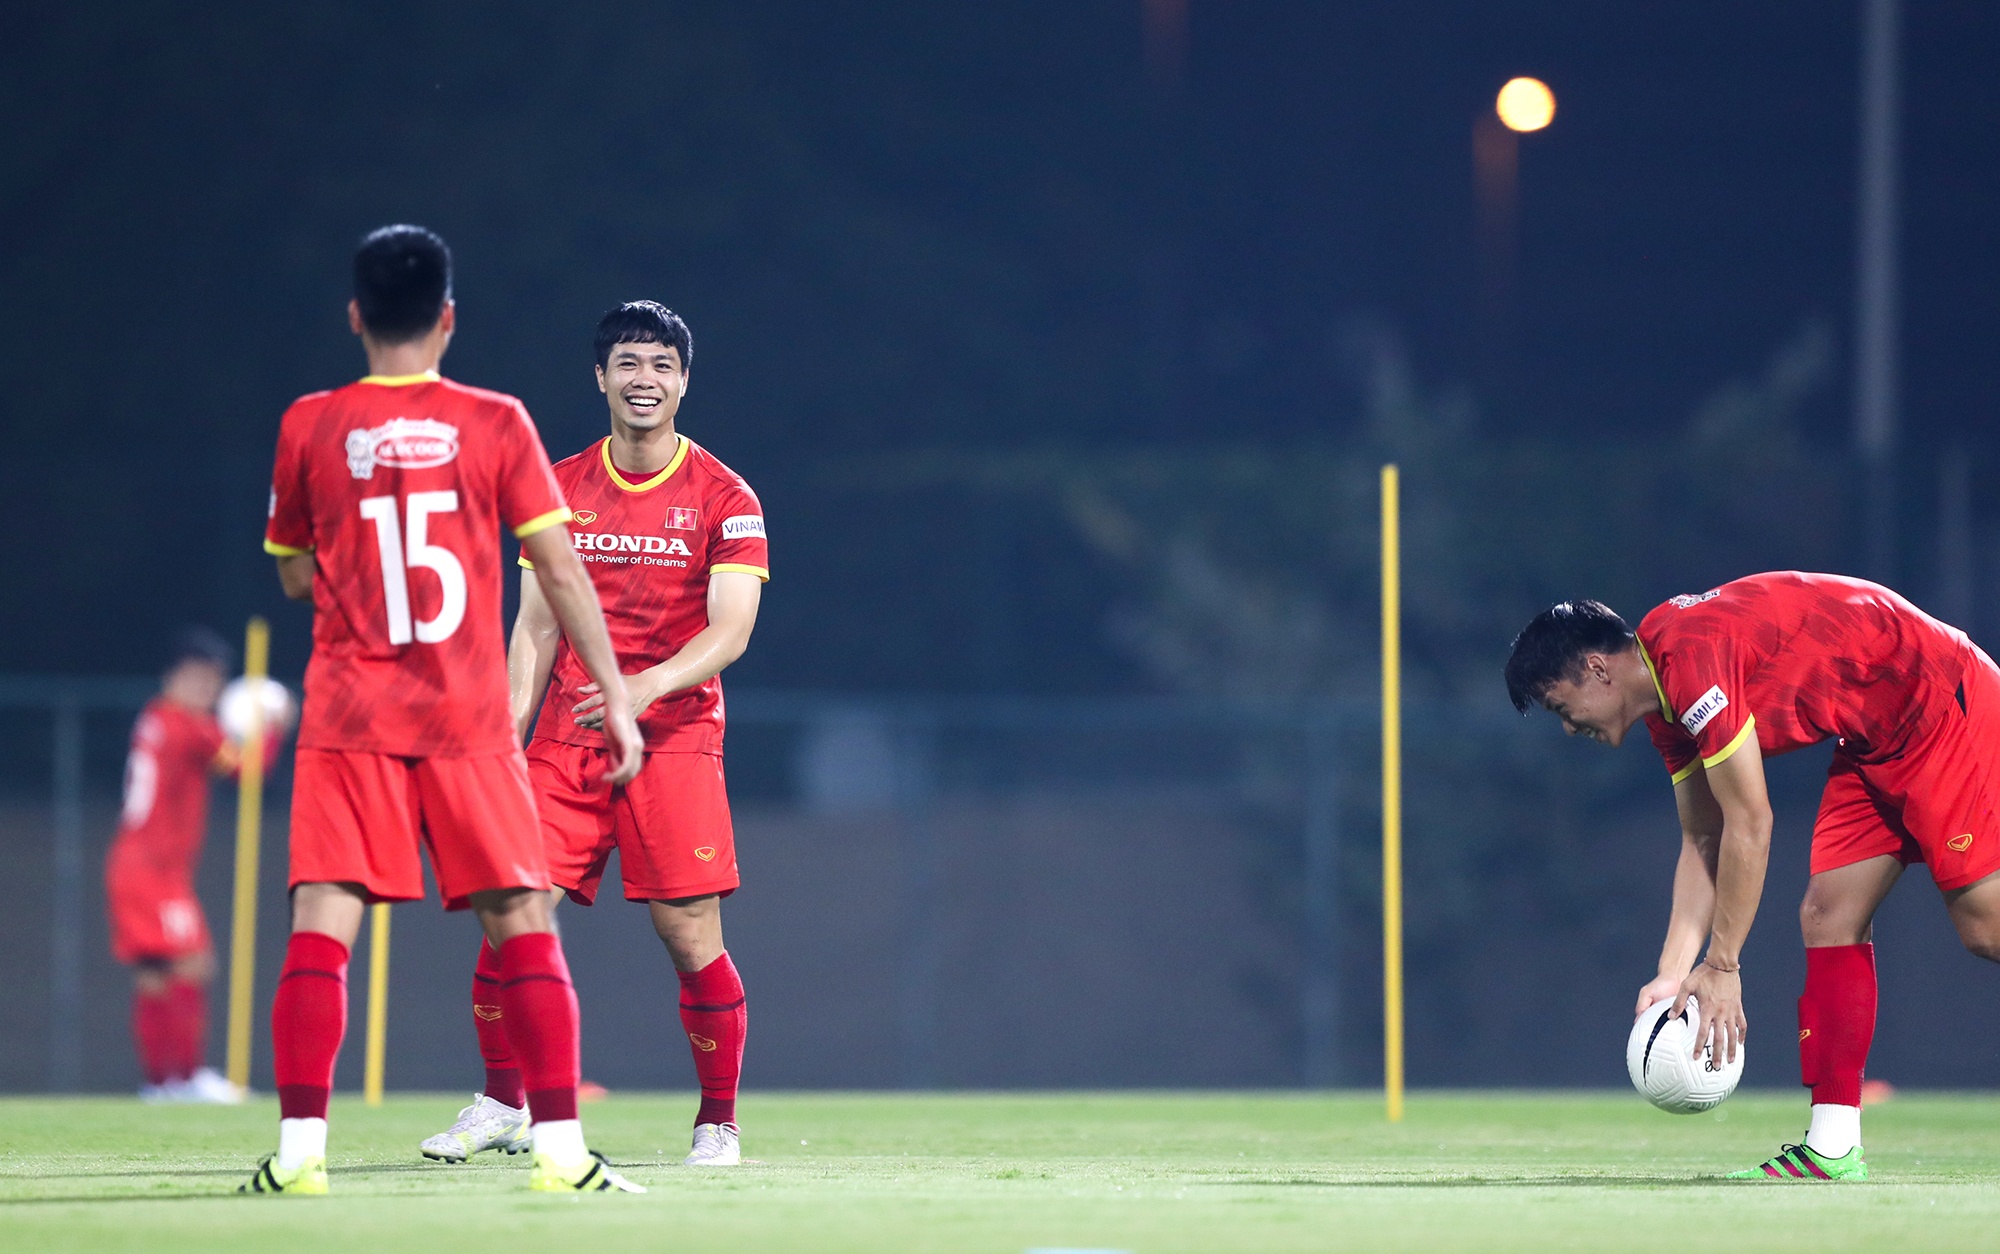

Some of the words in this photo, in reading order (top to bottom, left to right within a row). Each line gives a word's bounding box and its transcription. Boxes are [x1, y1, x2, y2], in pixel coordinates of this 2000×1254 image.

[573, 533, 692, 556] HONDA
[360, 490, 467, 644] 15
[577, 553, 593, 562] The
[596, 554, 628, 564] Power
[630, 556, 642, 564] of
[644, 556, 687, 568] Dreams
